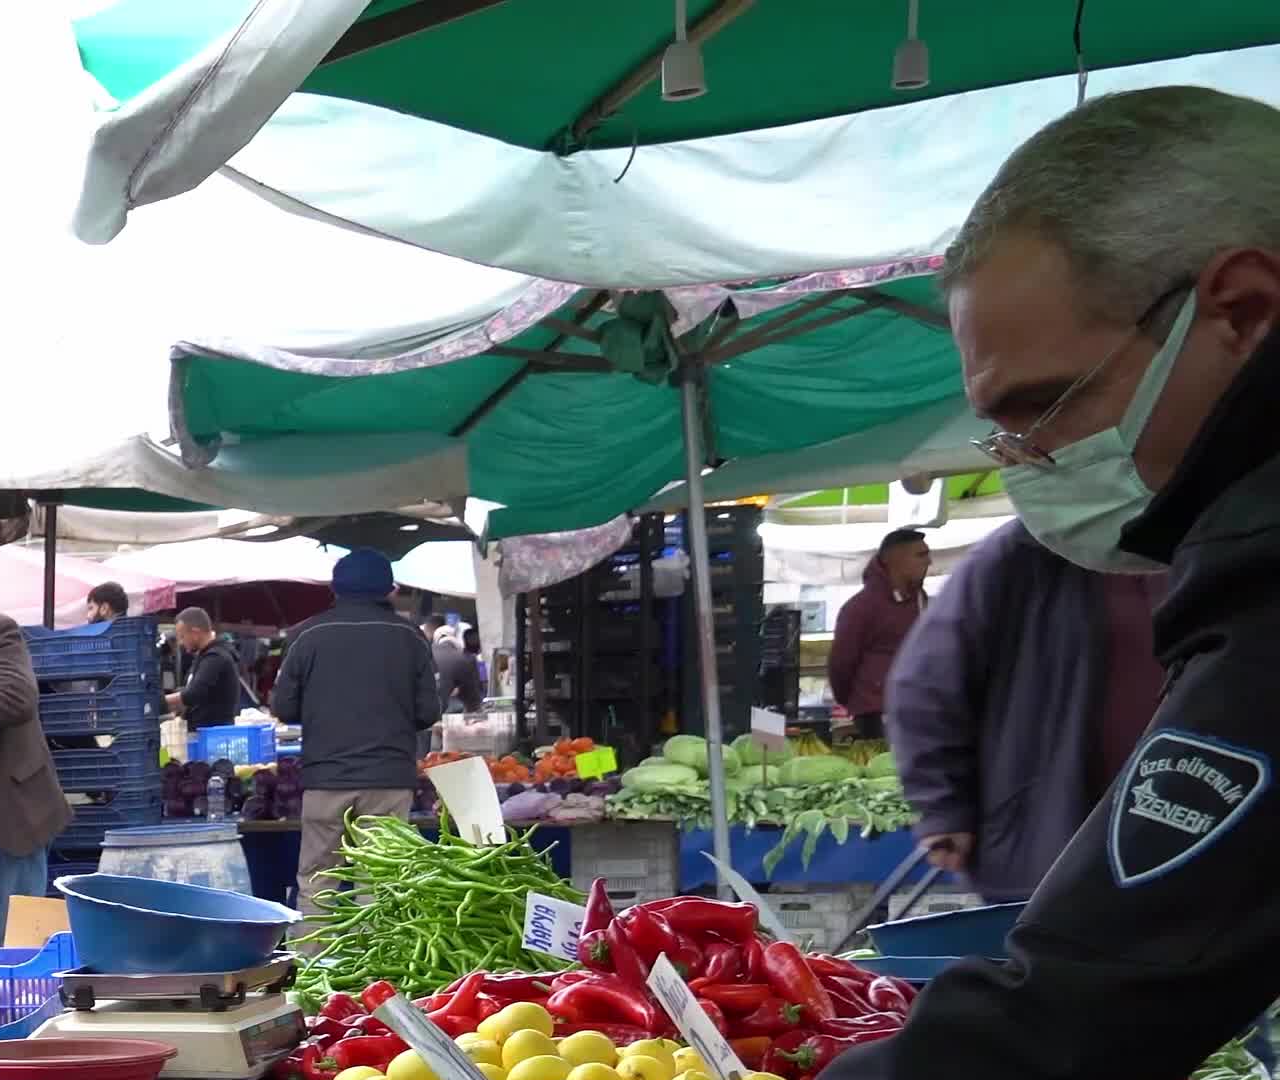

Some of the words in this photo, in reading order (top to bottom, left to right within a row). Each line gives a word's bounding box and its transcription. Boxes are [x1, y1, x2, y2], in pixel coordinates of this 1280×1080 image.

[1140, 759, 1175, 777] ÖZEL
[1175, 757, 1243, 804] GÜVENLİK
[524, 904, 556, 952] KAPYA
